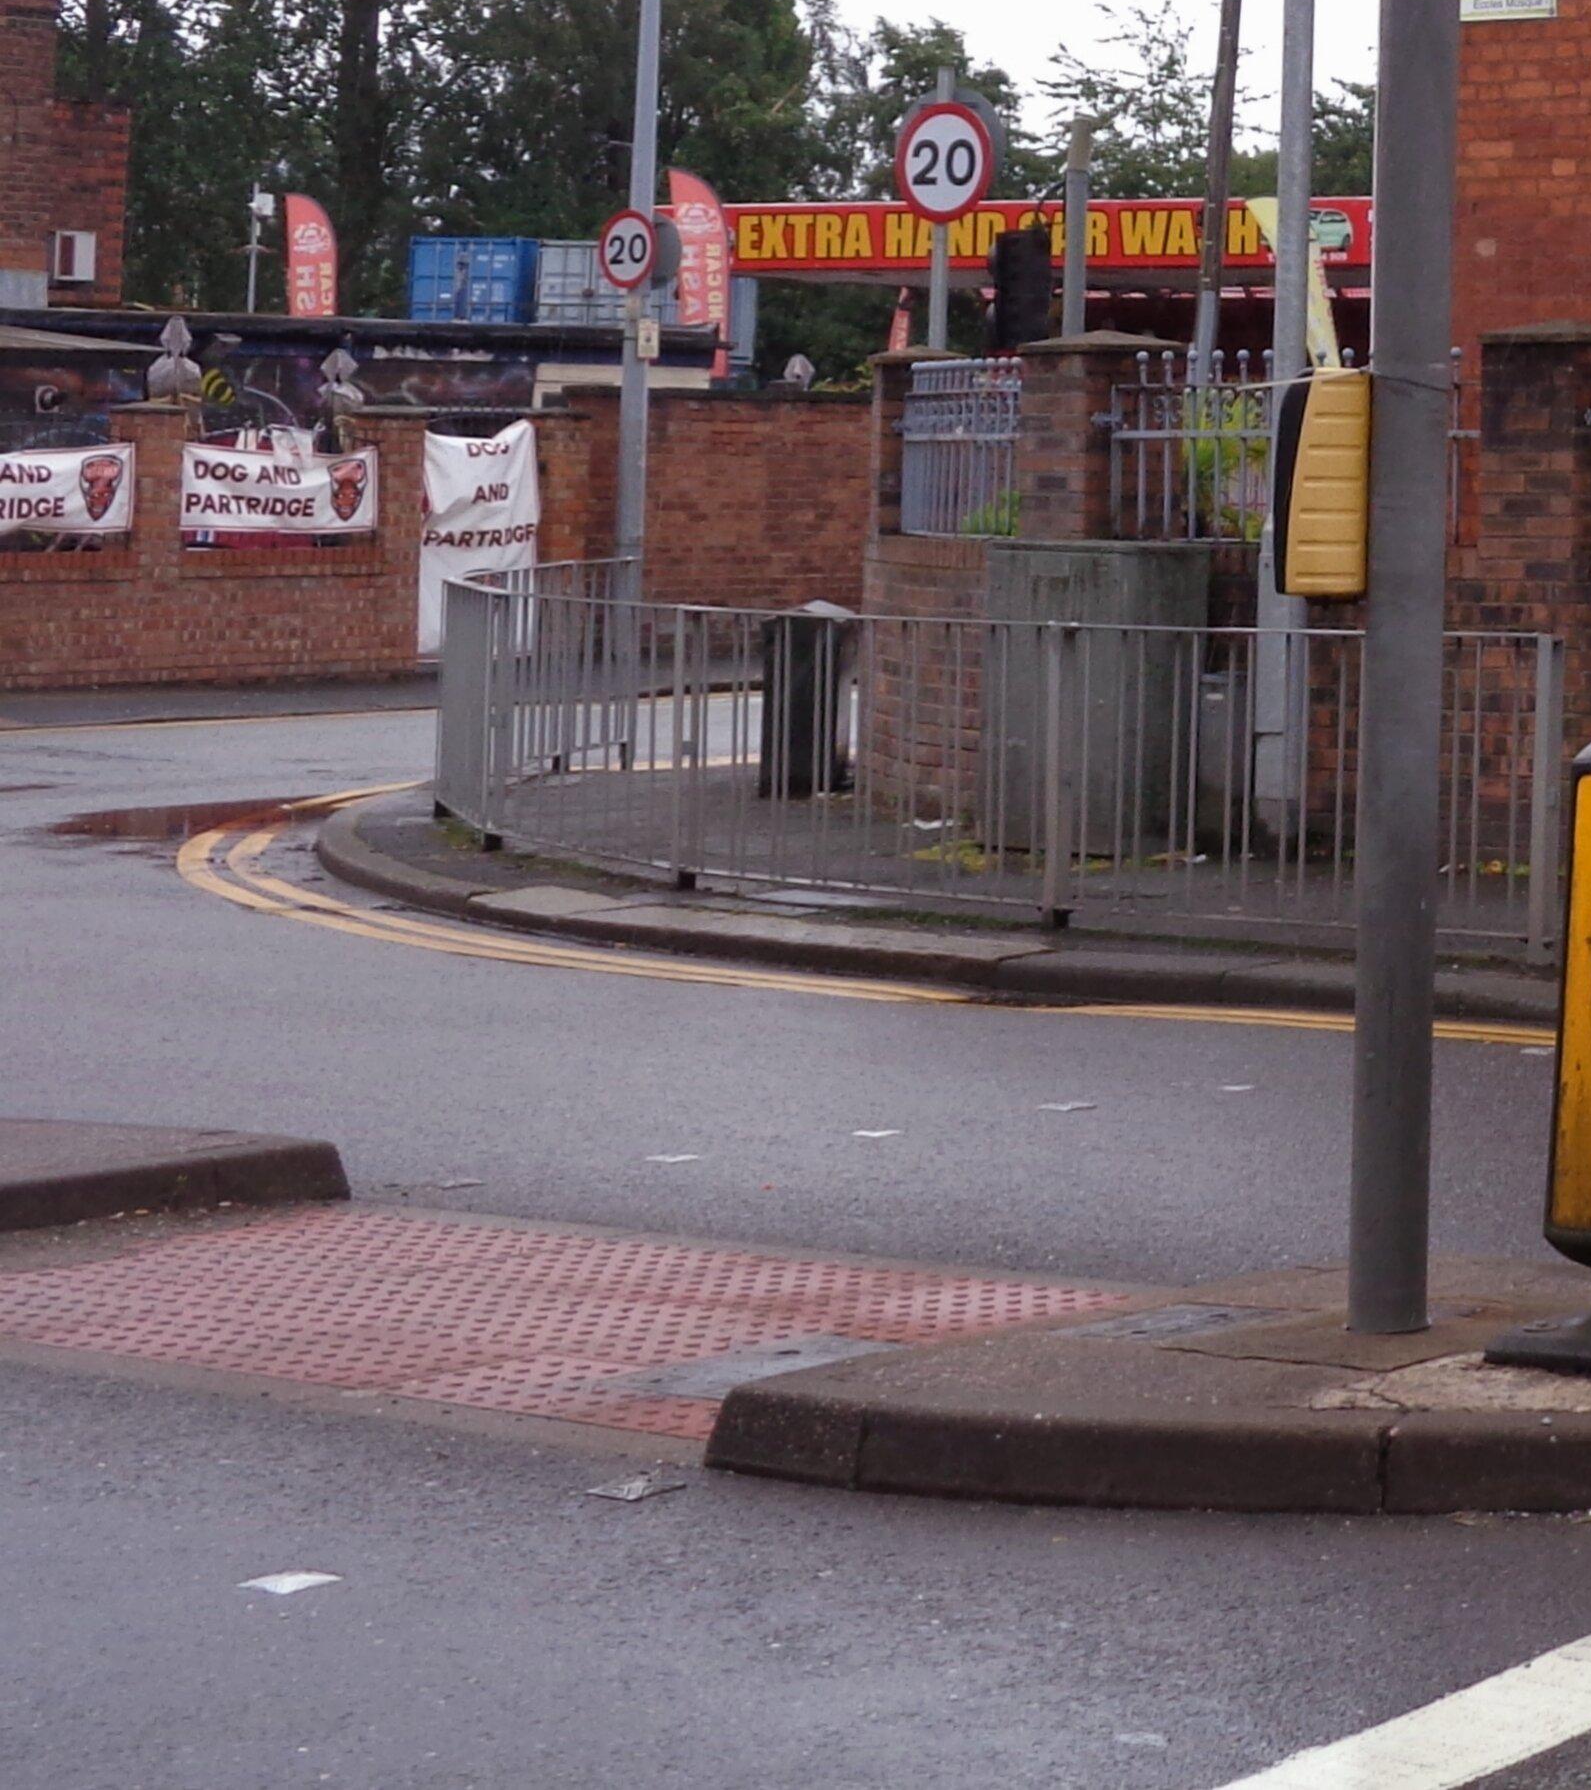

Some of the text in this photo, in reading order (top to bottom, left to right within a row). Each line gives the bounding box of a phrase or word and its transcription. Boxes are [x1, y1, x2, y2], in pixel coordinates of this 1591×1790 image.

[912, 138, 976, 187] 20
[737, 212, 874, 259] EXTRA
[1119, 209, 1259, 256] WAH
[608, 233, 648, 265] 20
[0, 462, 52, 485] AND
[193, 460, 301, 486] DOG AND
[184, 492, 316, 518] PARTRIDGE
[472, 482, 510, 505] AND
